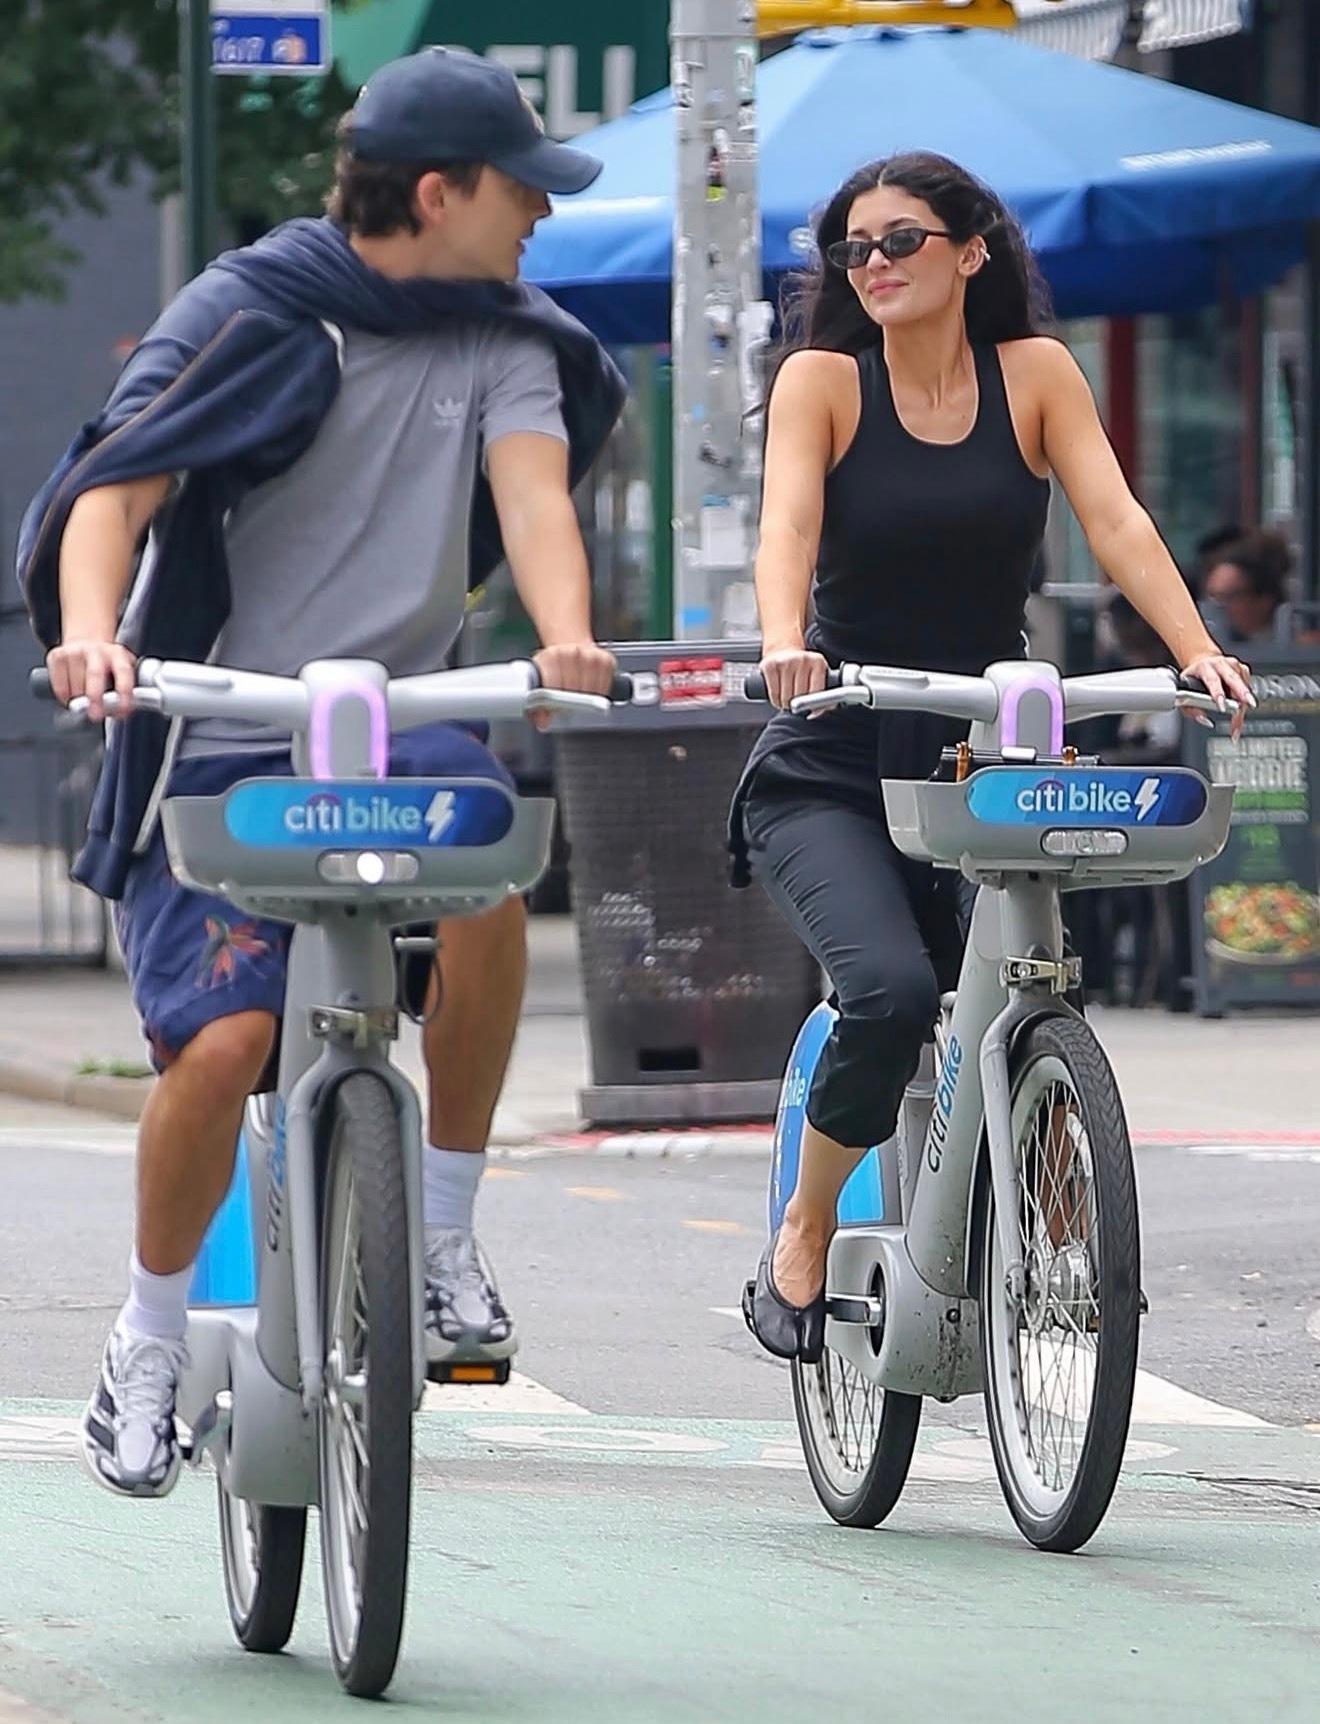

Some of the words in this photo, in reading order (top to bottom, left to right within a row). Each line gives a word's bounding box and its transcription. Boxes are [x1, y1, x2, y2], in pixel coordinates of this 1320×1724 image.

[284, 792, 341, 833] citi
[346, 796, 423, 832] bike
[1017, 778, 1064, 813] citi
[1068, 782, 1131, 813] bike
